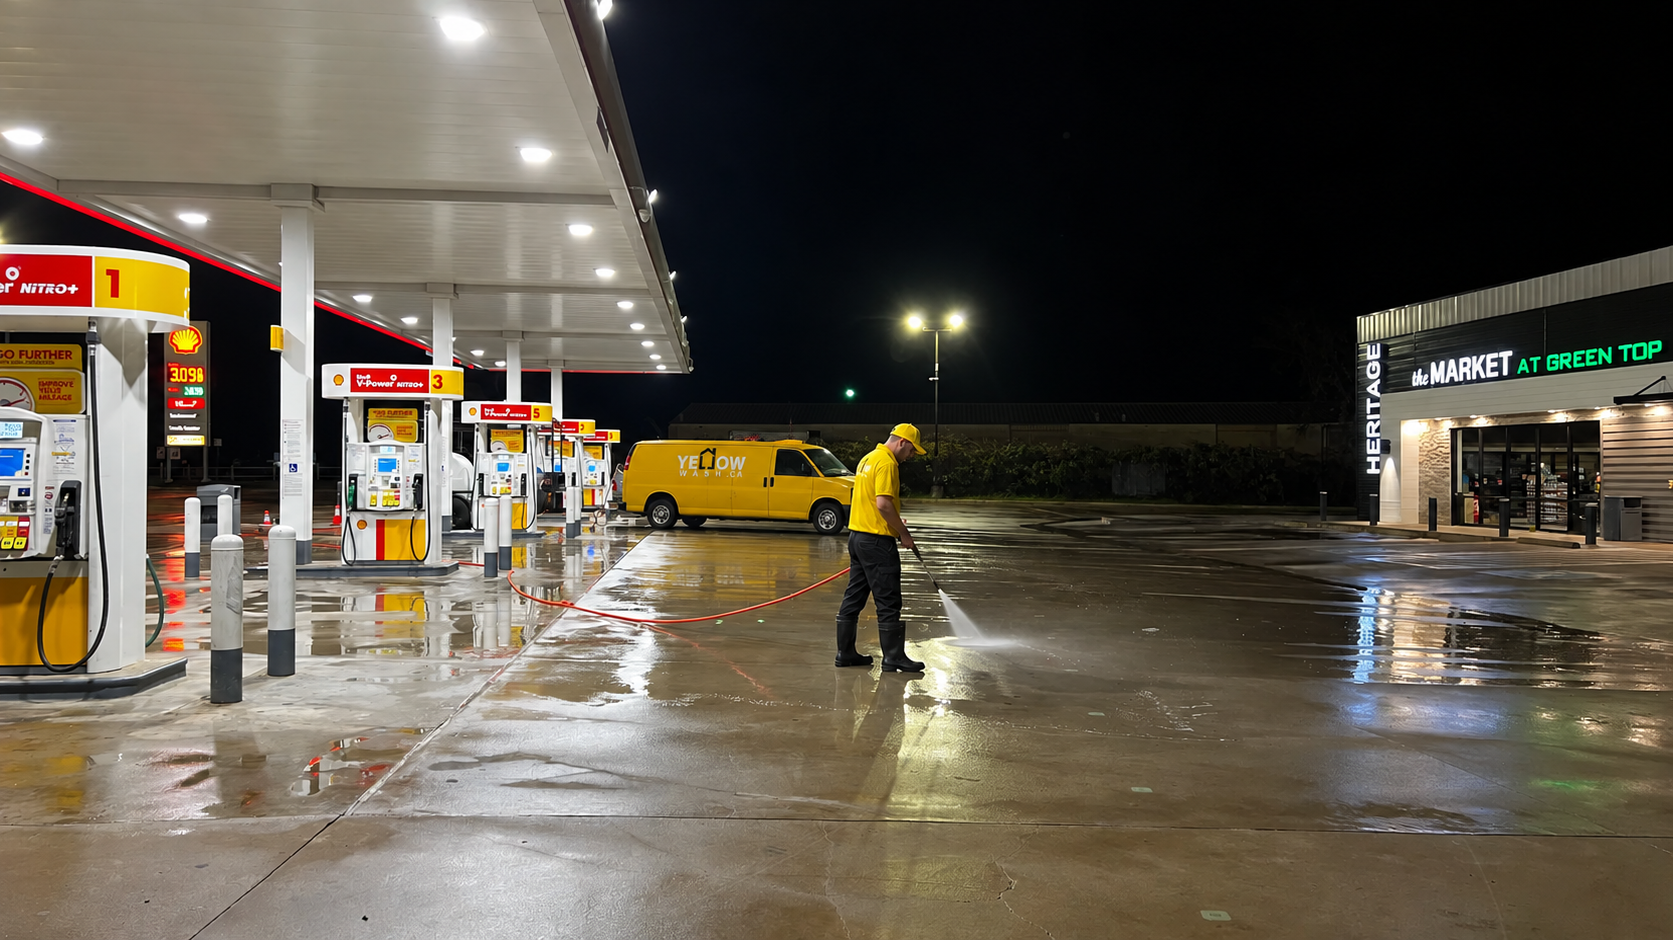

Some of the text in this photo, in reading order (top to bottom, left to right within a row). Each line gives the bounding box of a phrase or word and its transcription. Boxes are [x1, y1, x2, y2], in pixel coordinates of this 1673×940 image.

[105, 268, 120, 299] 1
[18, 349, 73, 360] FURTHER
[1411, 339, 1663, 387] the MARKET AT GREEN TOP
[432, 374, 444, 389] 3
[533, 408, 541, 419] 5
[1366, 342, 1381, 475] HERITAGE
